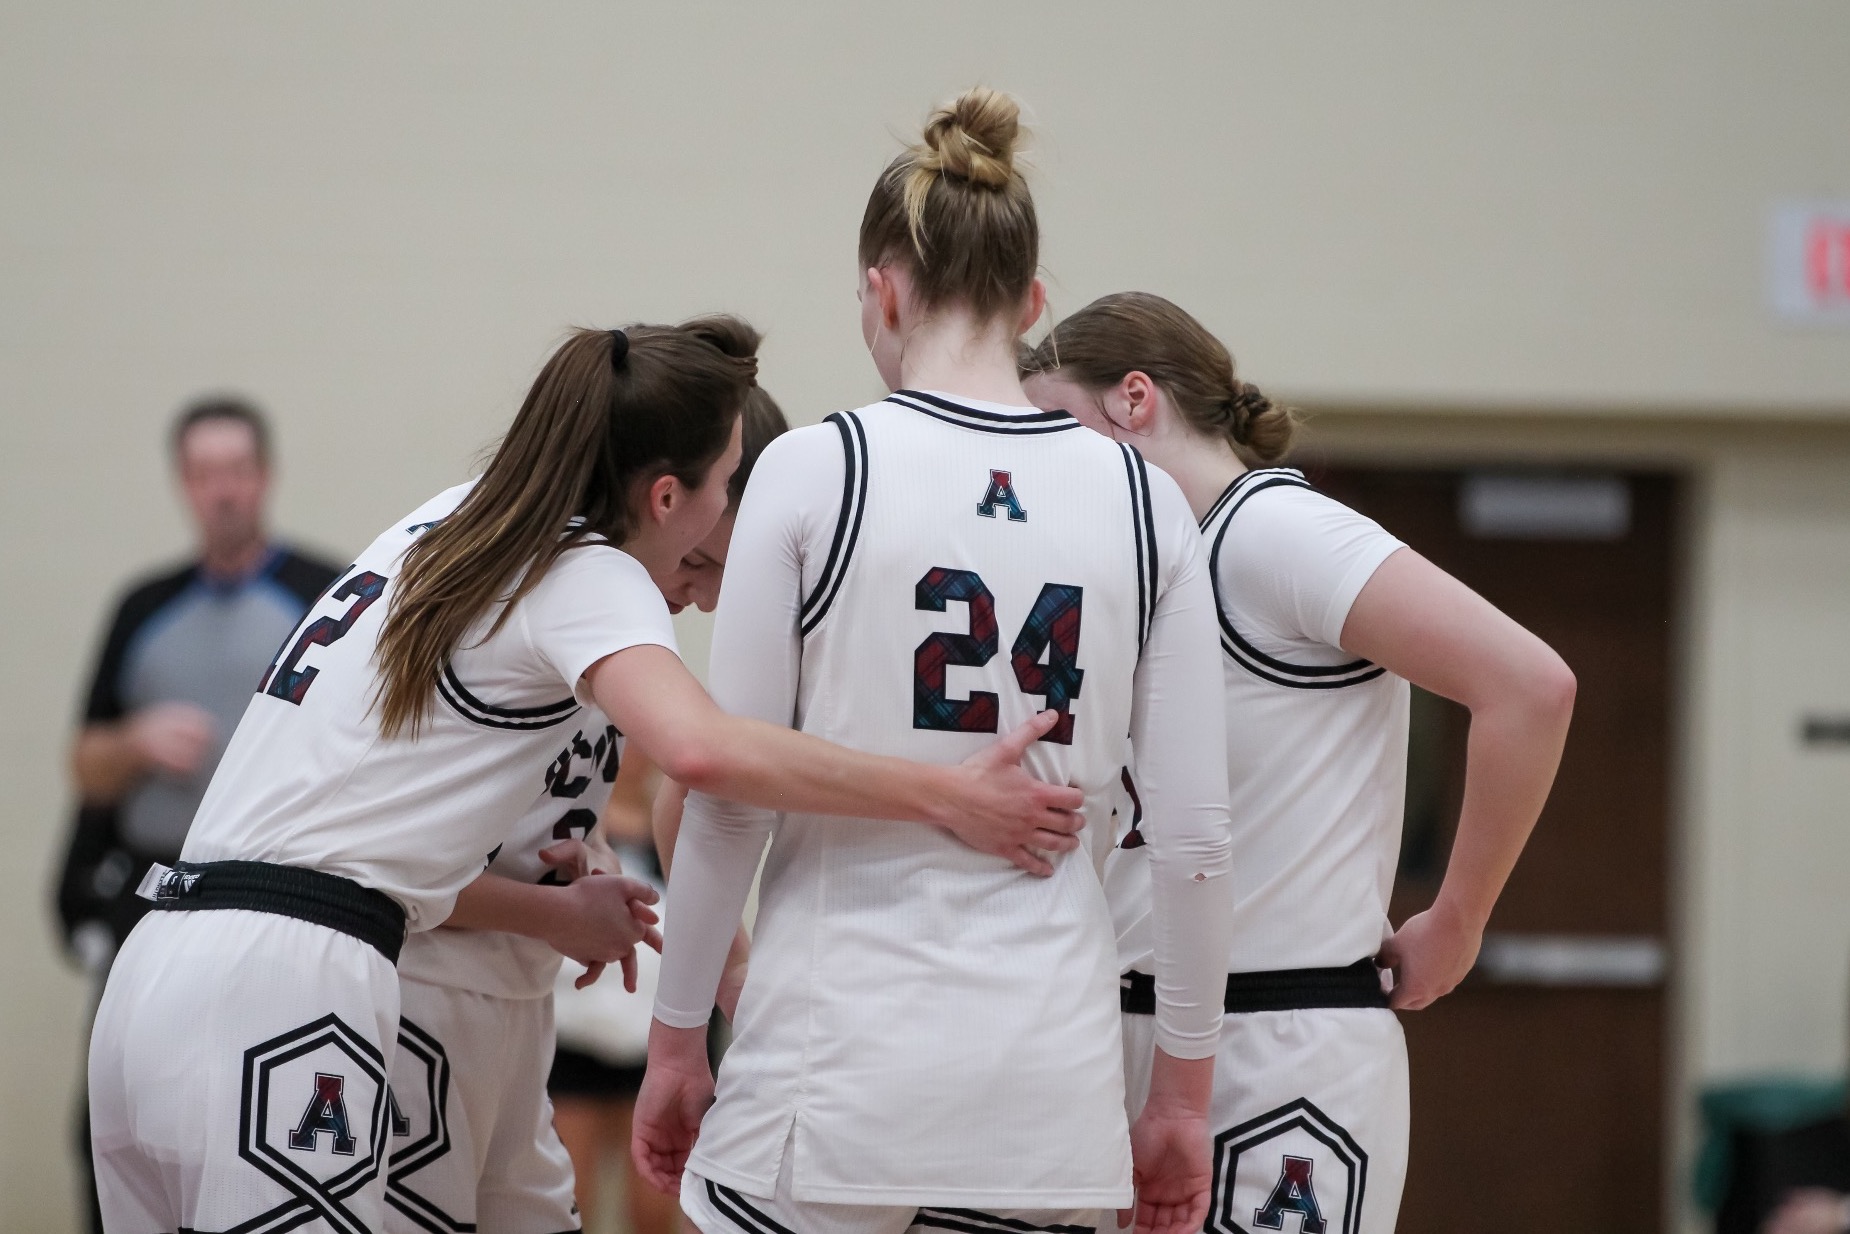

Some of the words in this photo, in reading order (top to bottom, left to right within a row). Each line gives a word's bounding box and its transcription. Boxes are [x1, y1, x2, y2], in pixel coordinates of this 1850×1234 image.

[976, 468, 1028, 523] A
[913, 566, 1085, 746] 24
[288, 1071, 357, 1156] A
[1253, 1154, 1328, 1234] A
